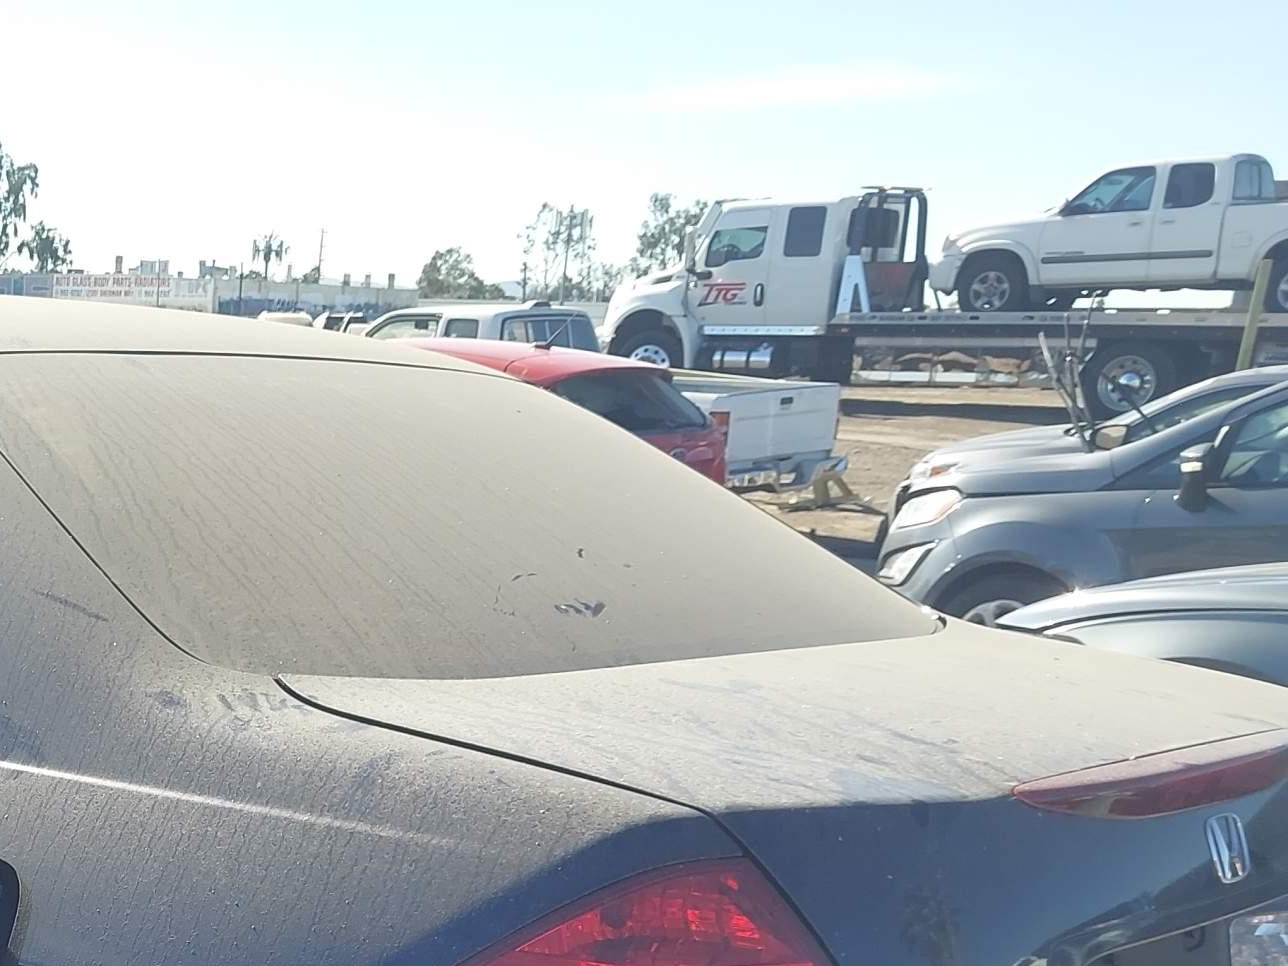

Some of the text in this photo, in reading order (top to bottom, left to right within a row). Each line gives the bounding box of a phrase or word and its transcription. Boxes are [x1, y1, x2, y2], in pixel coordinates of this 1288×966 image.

[73, 276, 92, 287] GLASS
[94, 277, 110, 287] BODY
[113, 277, 132, 288] PARTS
[135, 277, 171, 288] RADIATORS
